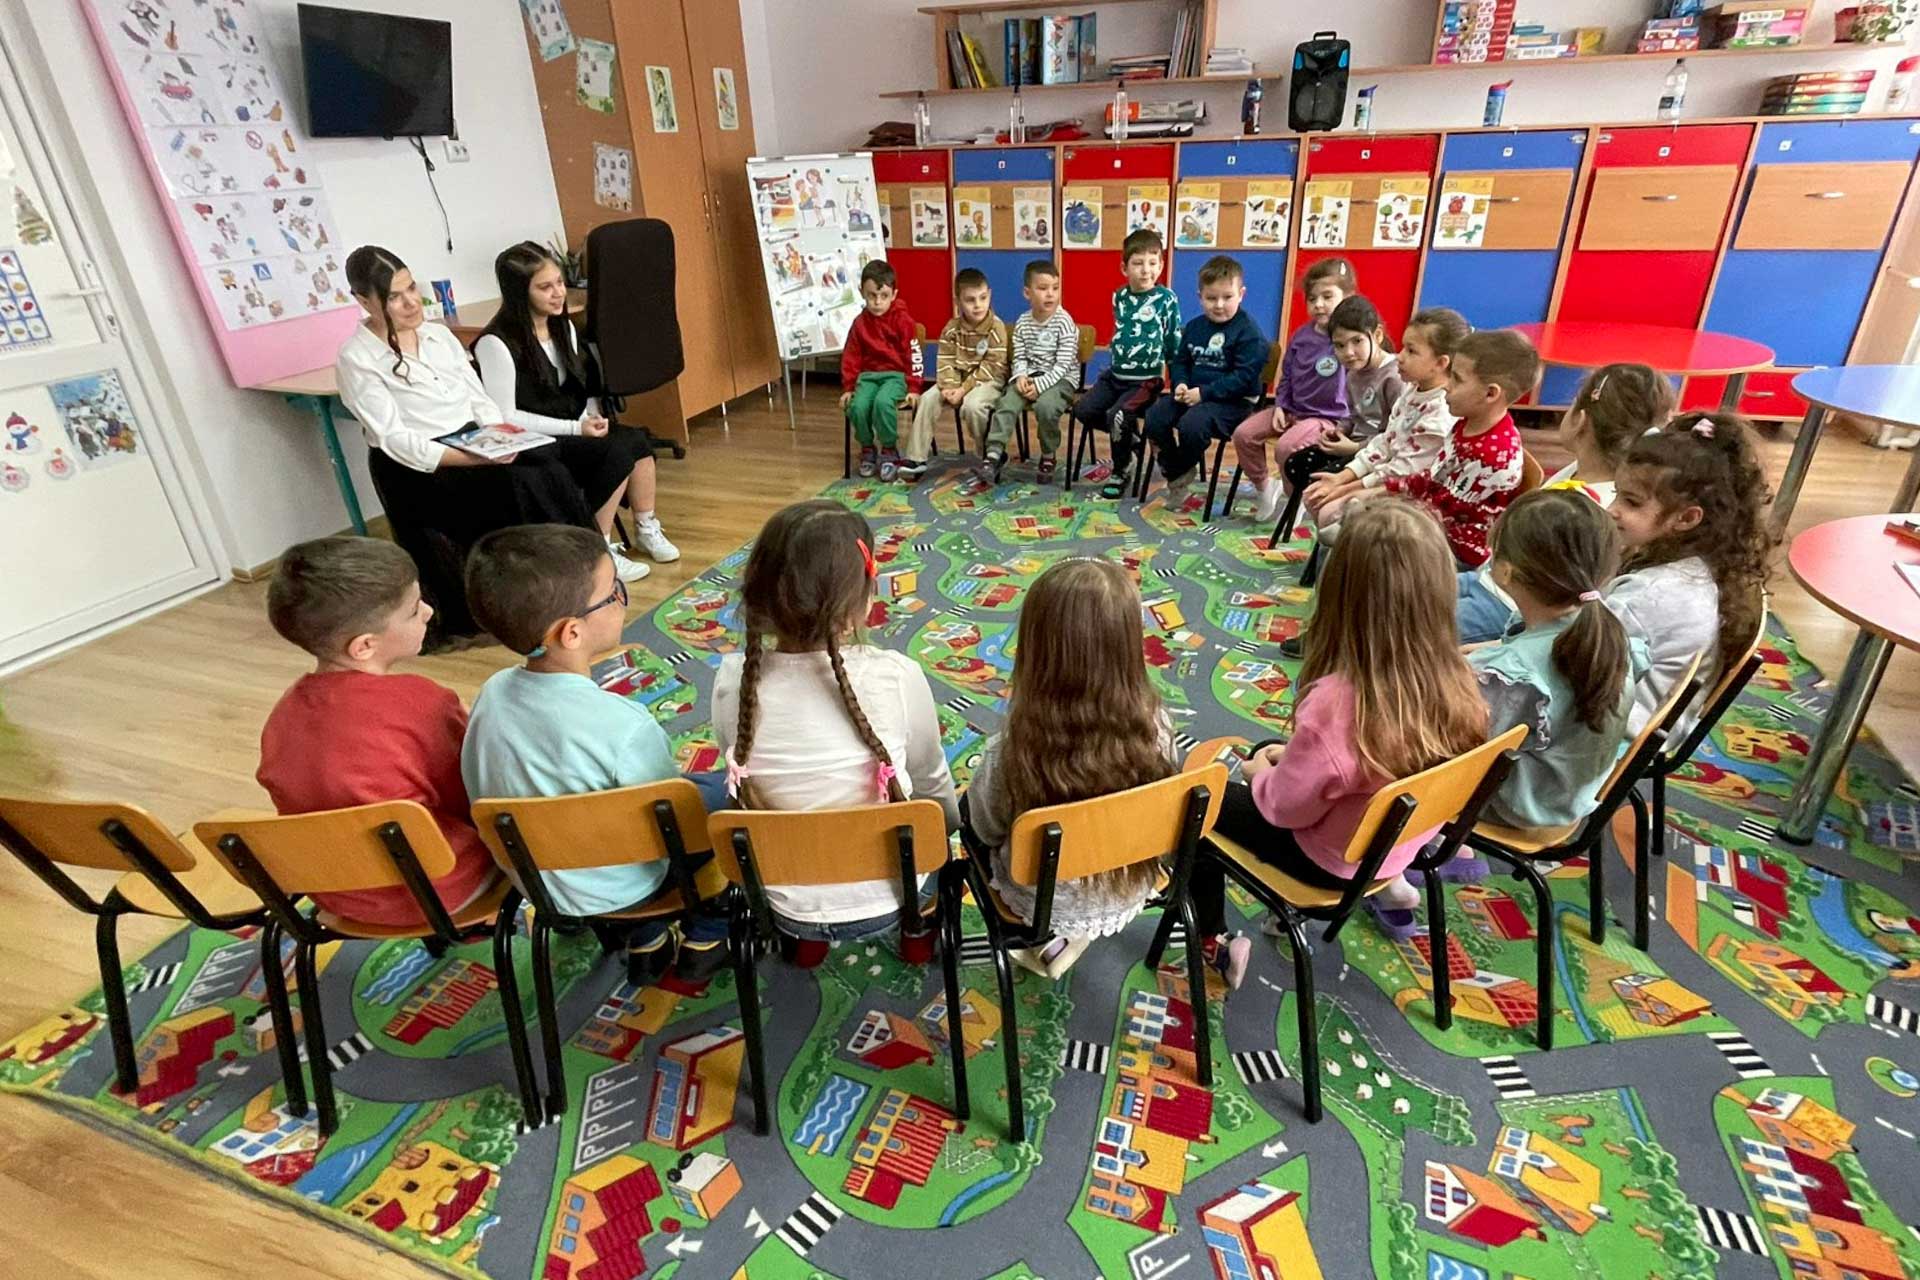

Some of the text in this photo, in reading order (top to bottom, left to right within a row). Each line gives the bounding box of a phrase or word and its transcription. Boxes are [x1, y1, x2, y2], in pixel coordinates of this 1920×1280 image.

[594, 1077, 616, 1091] P
[591, 1098, 614, 1113] P
[587, 1123, 609, 1137] P
[583, 1144, 606, 1160] P
[1140, 1254, 1164, 1275] P
